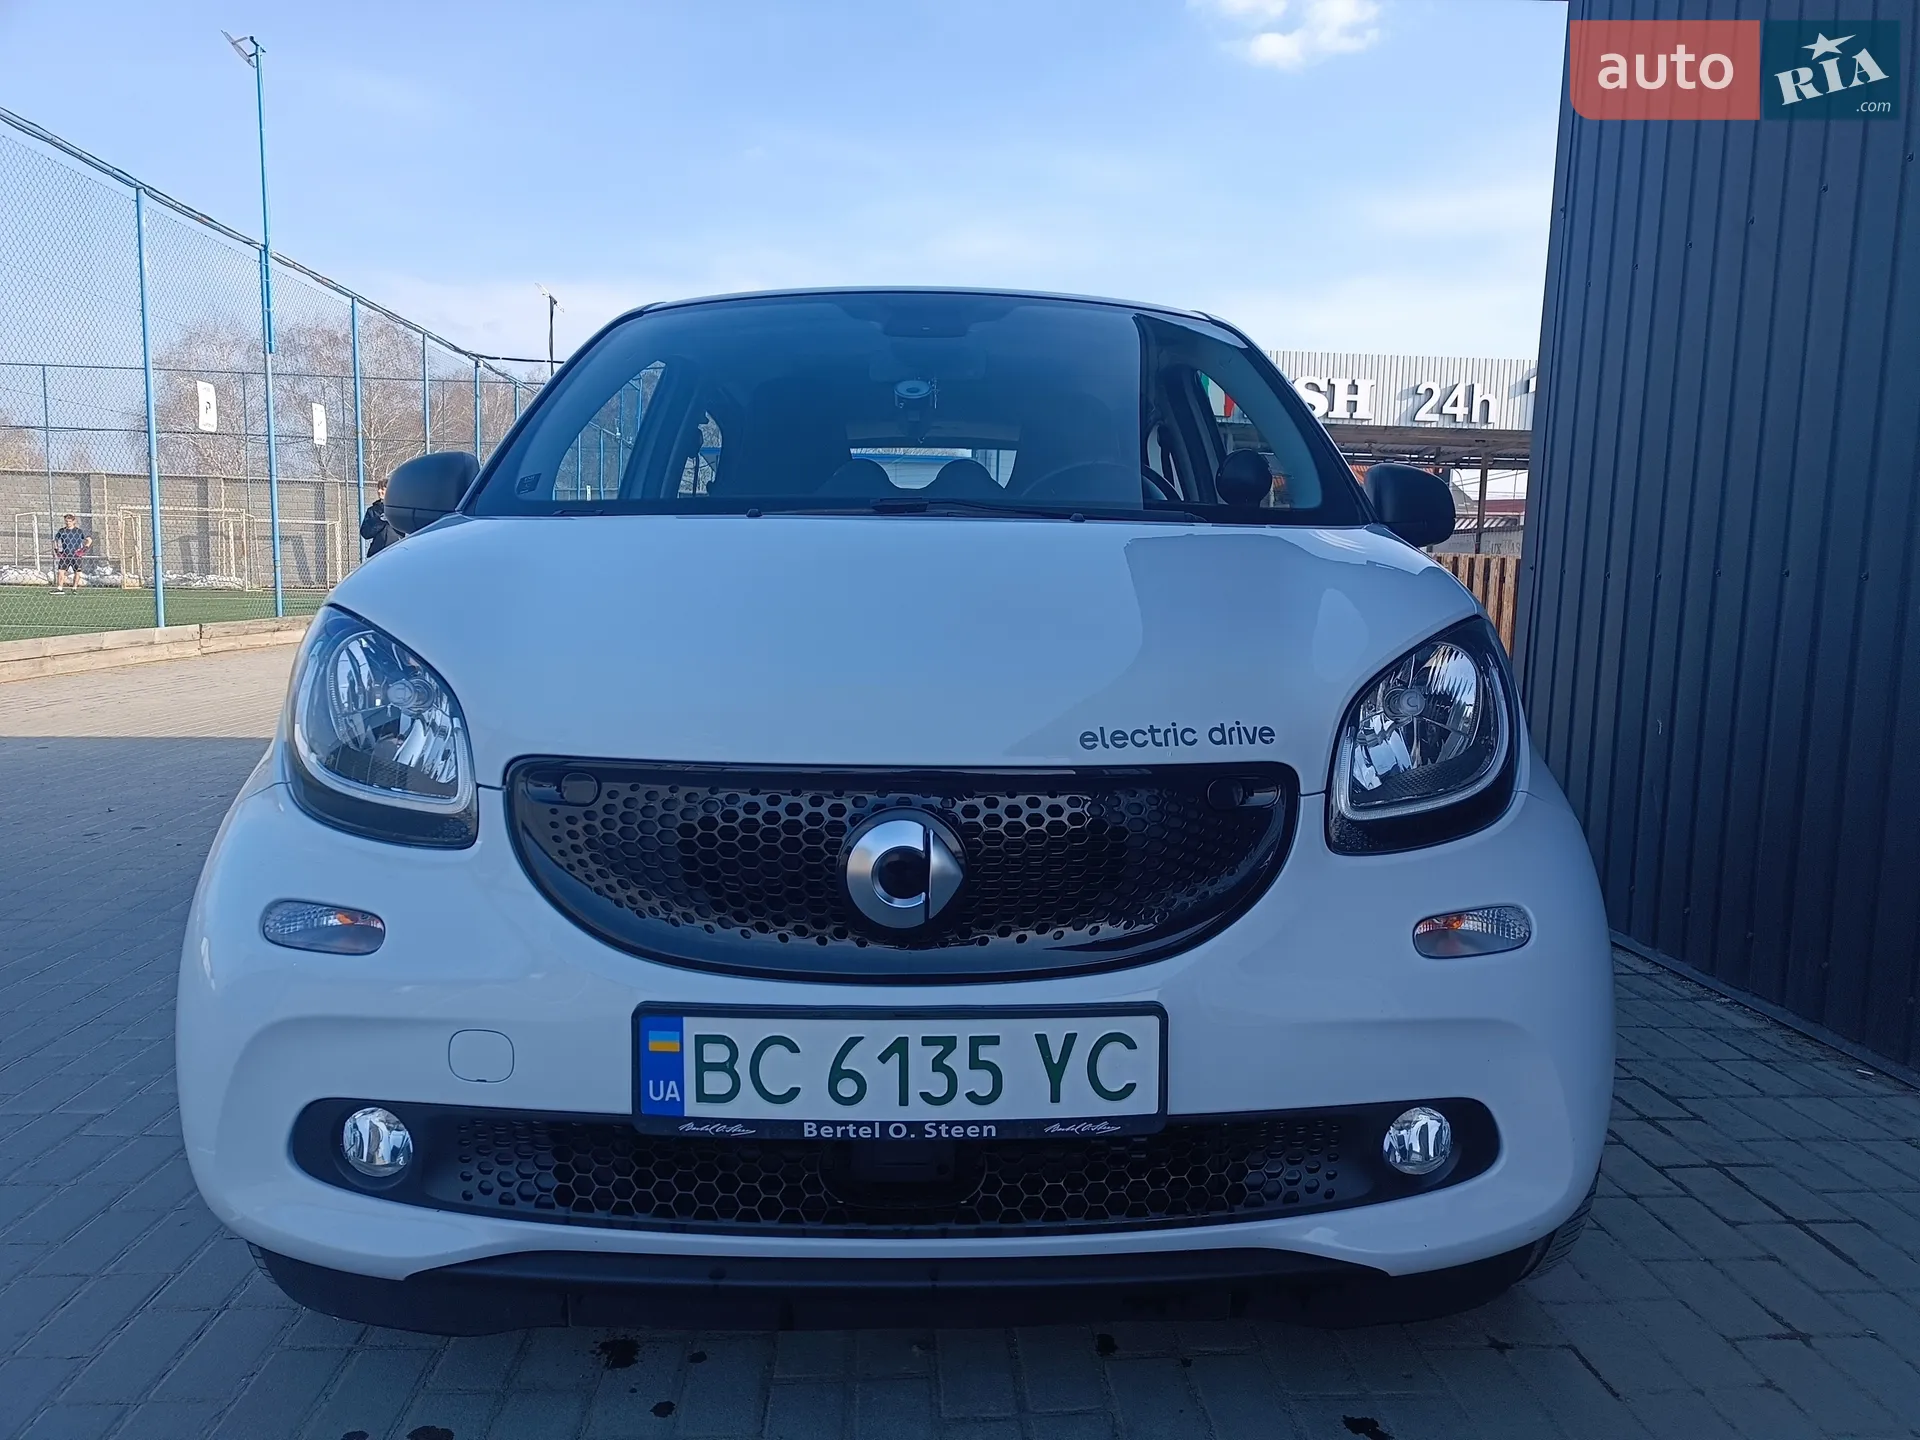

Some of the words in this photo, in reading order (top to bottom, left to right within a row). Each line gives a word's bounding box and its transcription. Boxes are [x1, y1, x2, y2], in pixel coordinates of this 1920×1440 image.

[1413, 380, 1496, 424] 24h
[1079, 721, 1199, 750] electric
[1207, 720, 1276, 746] drive
[694, 1033, 802, 1105] BC
[827, 1034, 1004, 1107] 6135
[1033, 1031, 1139, 1103] YC
[648, 1080, 681, 1102] UA
[803, 1121, 880, 1139] Bertel
[888, 1122, 916, 1139] O.
[924, 1121, 997, 1138] Steen
